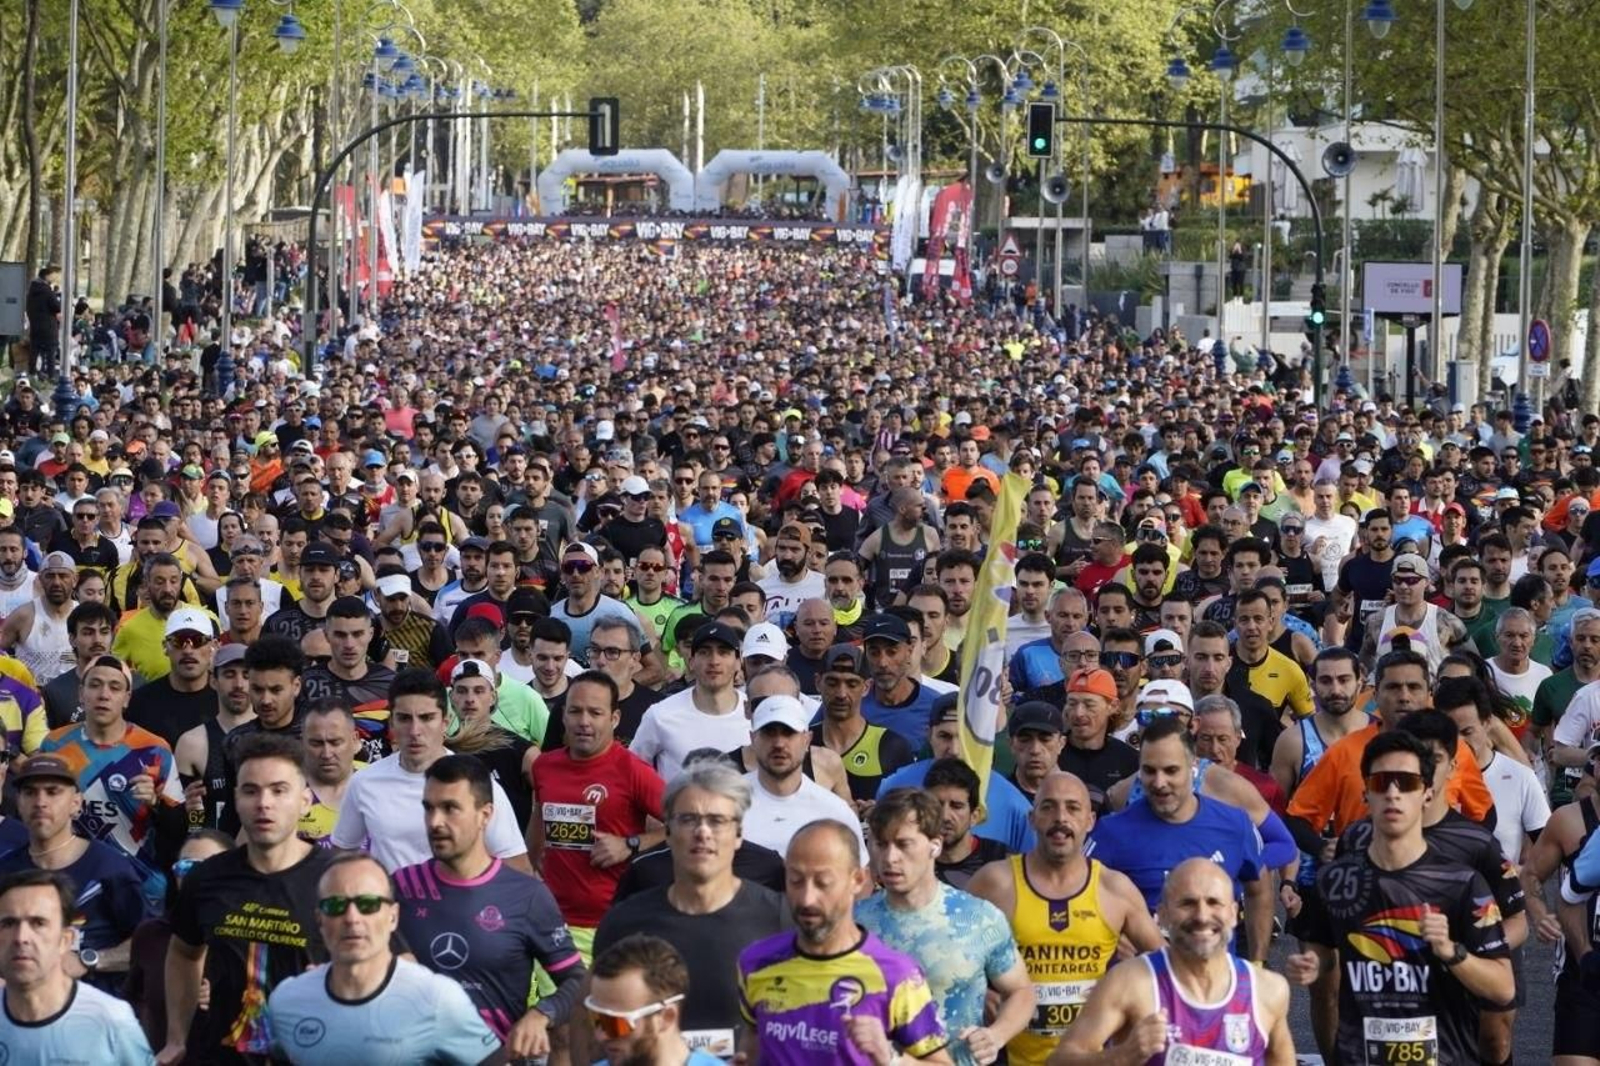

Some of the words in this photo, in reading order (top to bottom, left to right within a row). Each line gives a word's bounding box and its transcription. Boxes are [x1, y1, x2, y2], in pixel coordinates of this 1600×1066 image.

[306, 679, 331, 700] 25
[550, 822, 589, 840] 2629
[1329, 866, 1359, 900] 25
[224, 913, 247, 927] SAN
[248, 917, 300, 934] MARTIÑO
[1018, 944, 1101, 960] ANINOS
[765, 1021, 839, 1047] PRIVILEGE
[1384, 1042, 1425, 1062] 785
